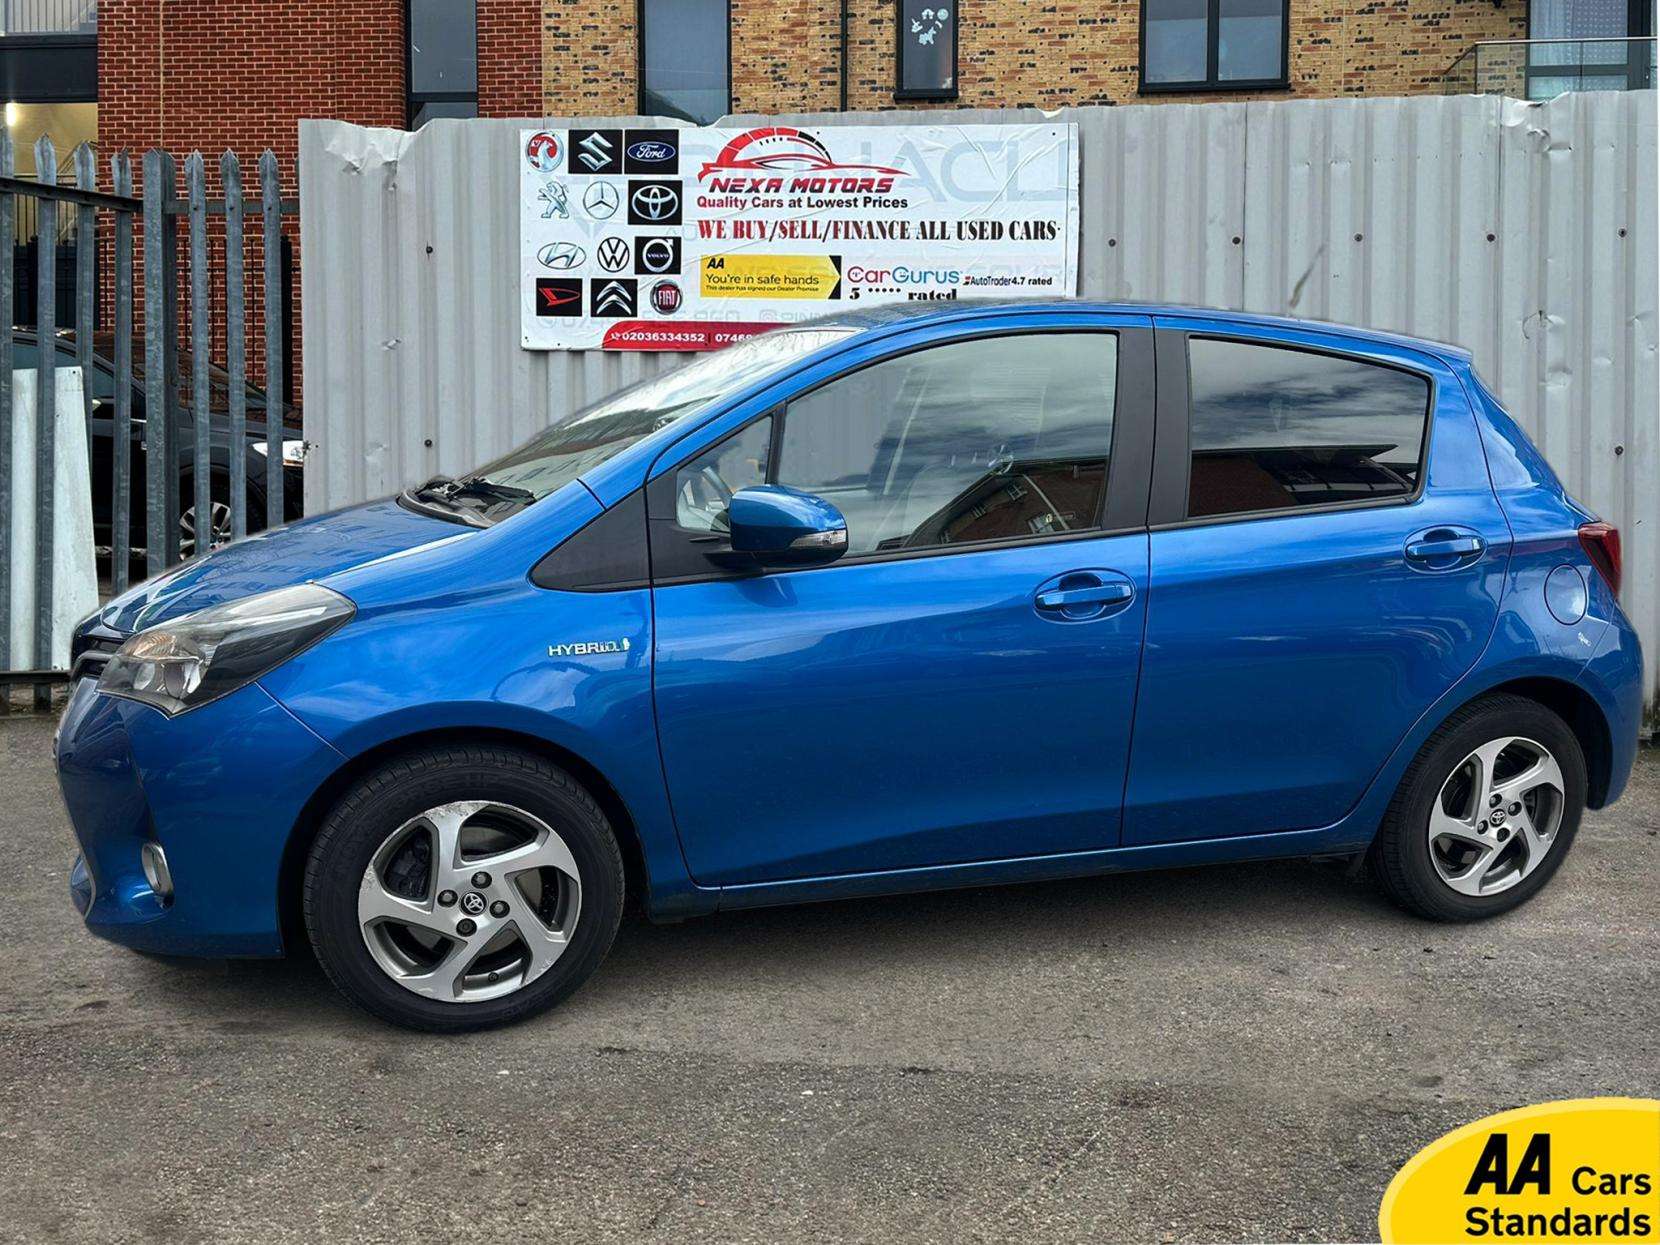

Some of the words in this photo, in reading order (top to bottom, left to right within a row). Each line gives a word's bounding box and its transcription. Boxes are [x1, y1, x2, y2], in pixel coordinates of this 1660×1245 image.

[636, 144, 666, 159] Ford
[709, 178, 784, 193] NEXA
[789, 177, 895, 193] MOTORS
[697, 196, 747, 210] Quality
[751, 196, 784, 208] Cars
[788, 197, 802, 208] at
[806, 197, 859, 208] Lowest
[862, 197, 908, 208] Prices
[697, 219, 726, 240] WE
[916, 220, 951, 240] ALL
[956, 220, 1004, 240] USED
[706, 257, 725, 269] AA
[705, 273, 740, 285] You're
[744, 273, 754, 284] in
[757, 274, 781, 285] safe
[784, 274, 820, 286] hands
[847, 266, 960, 284] CarGurus
[1028, 276, 1053, 286] rated
[658, 290, 676, 306] FIAT
[849, 287, 860, 300] 5
[908, 288, 957, 301] rated
[621, 332, 705, 342] 02036334352
